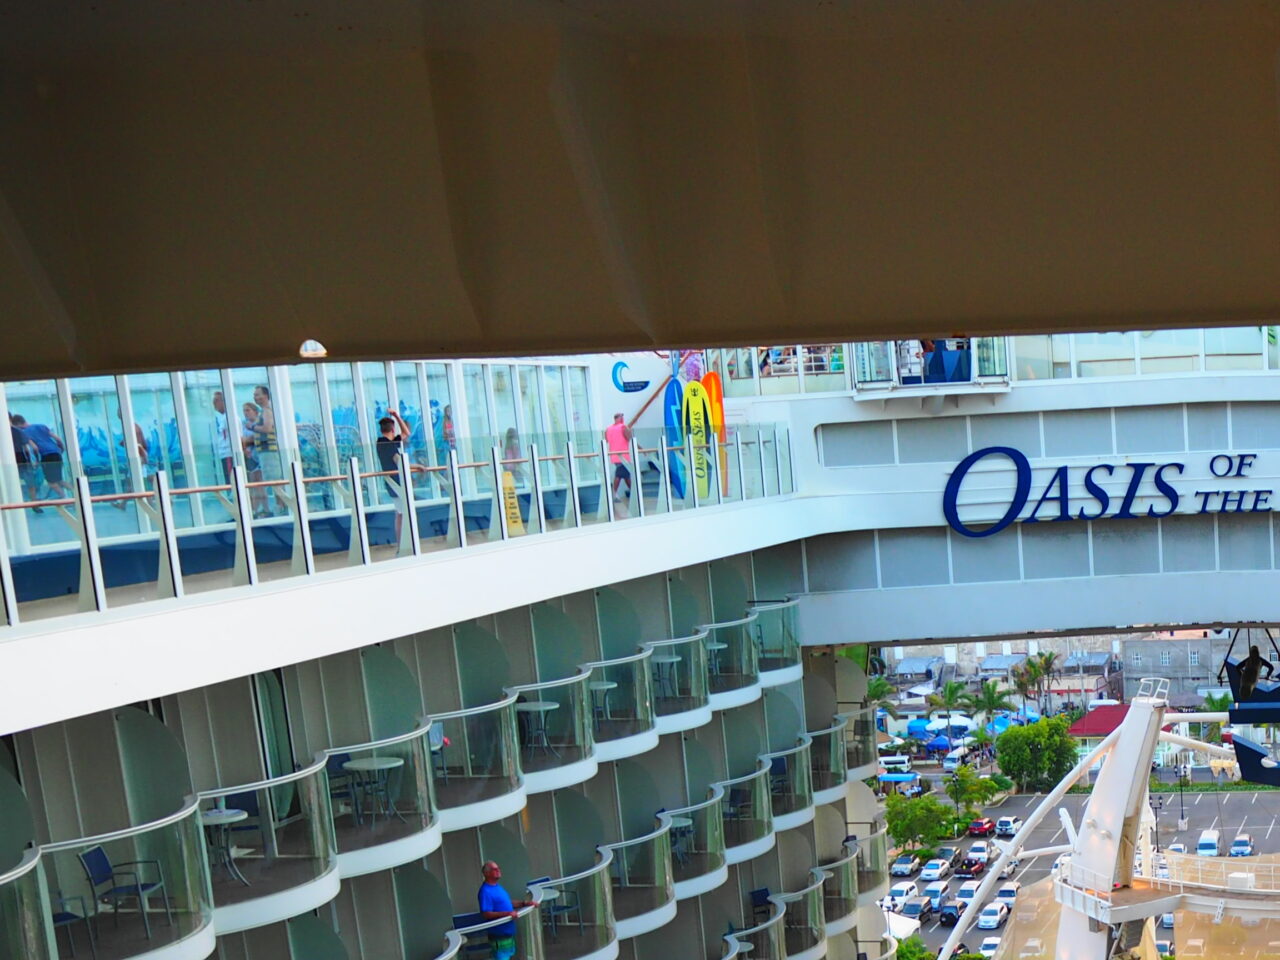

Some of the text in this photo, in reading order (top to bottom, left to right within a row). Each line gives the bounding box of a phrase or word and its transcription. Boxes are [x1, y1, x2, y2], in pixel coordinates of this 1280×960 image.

[1209, 453, 1257, 477] OF
[942, 446, 1185, 538] OASIS
[1194, 489, 1273, 513] THE
